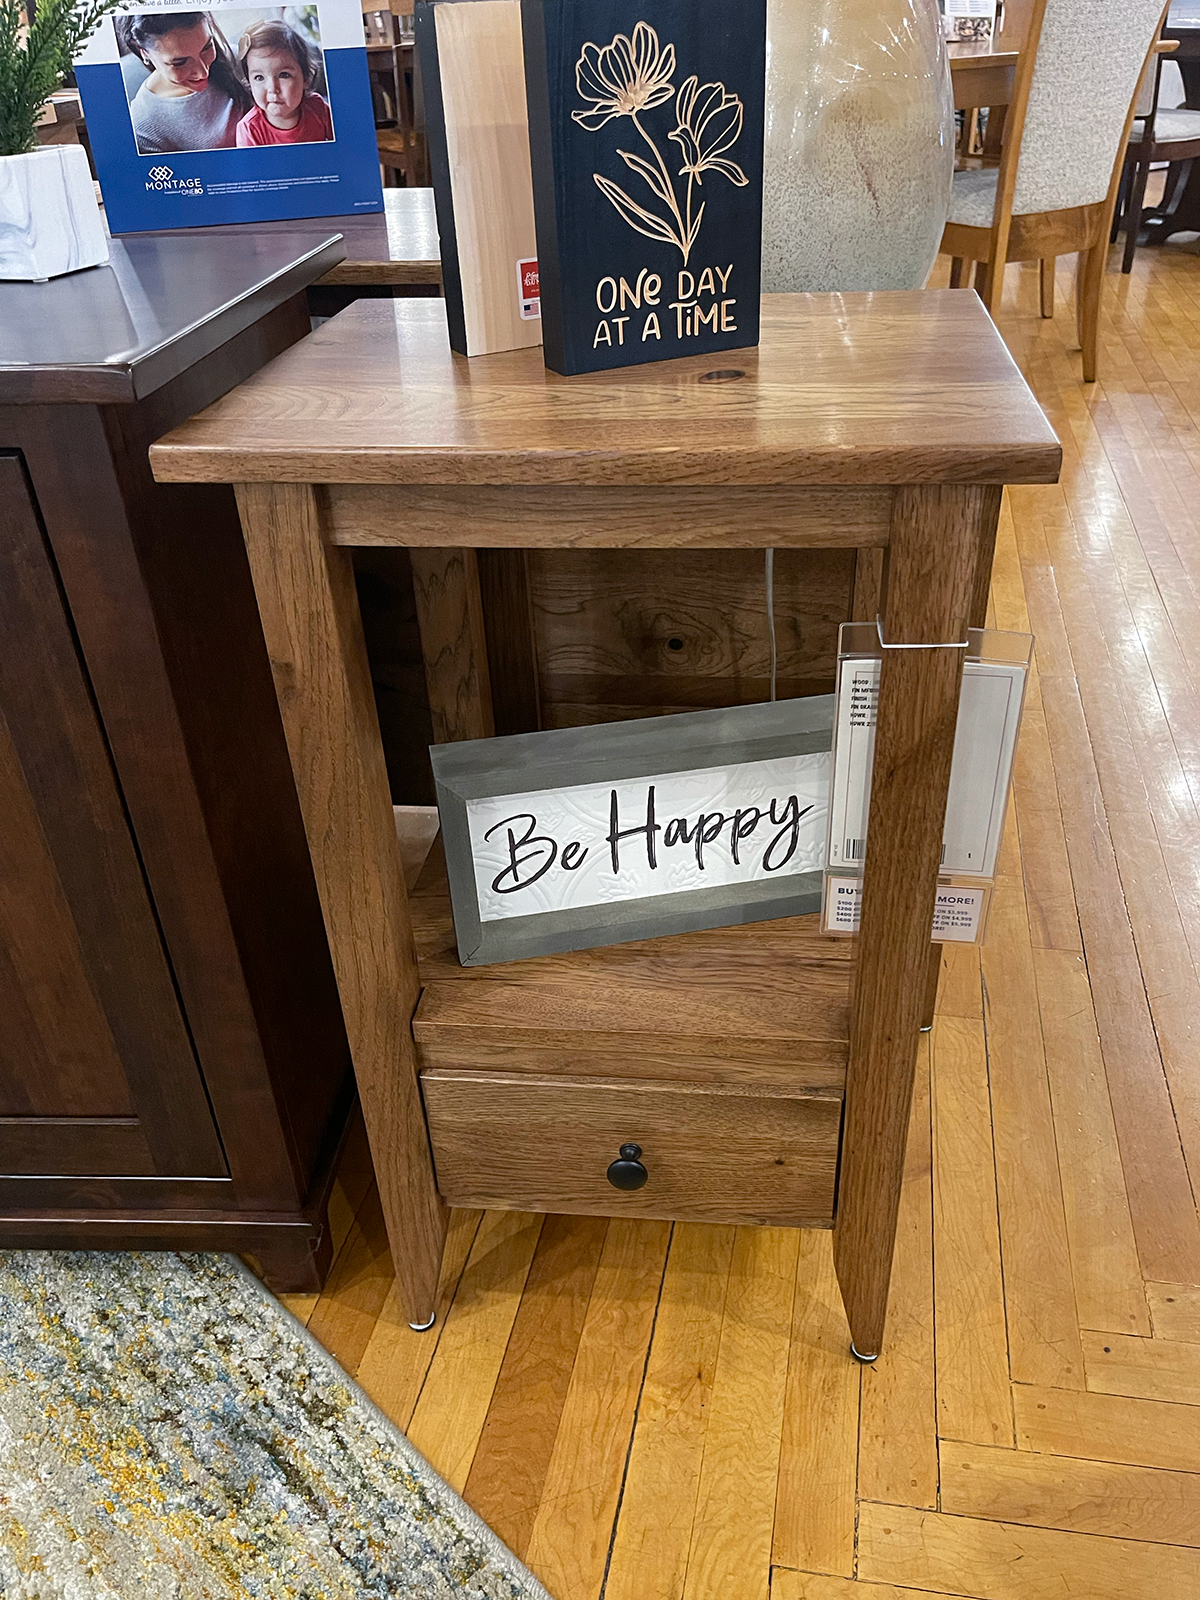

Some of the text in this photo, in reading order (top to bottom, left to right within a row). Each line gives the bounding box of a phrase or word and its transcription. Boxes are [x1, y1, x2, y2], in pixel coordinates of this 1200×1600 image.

[145, 178, 202, 191] MONTAGE
[678, 263, 734, 300] DAY
[593, 316, 631, 349] AT
[641, 312, 661, 342] A
[484, 785, 815, 894] Be Happy
[938, 896, 974, 905] MORE!
